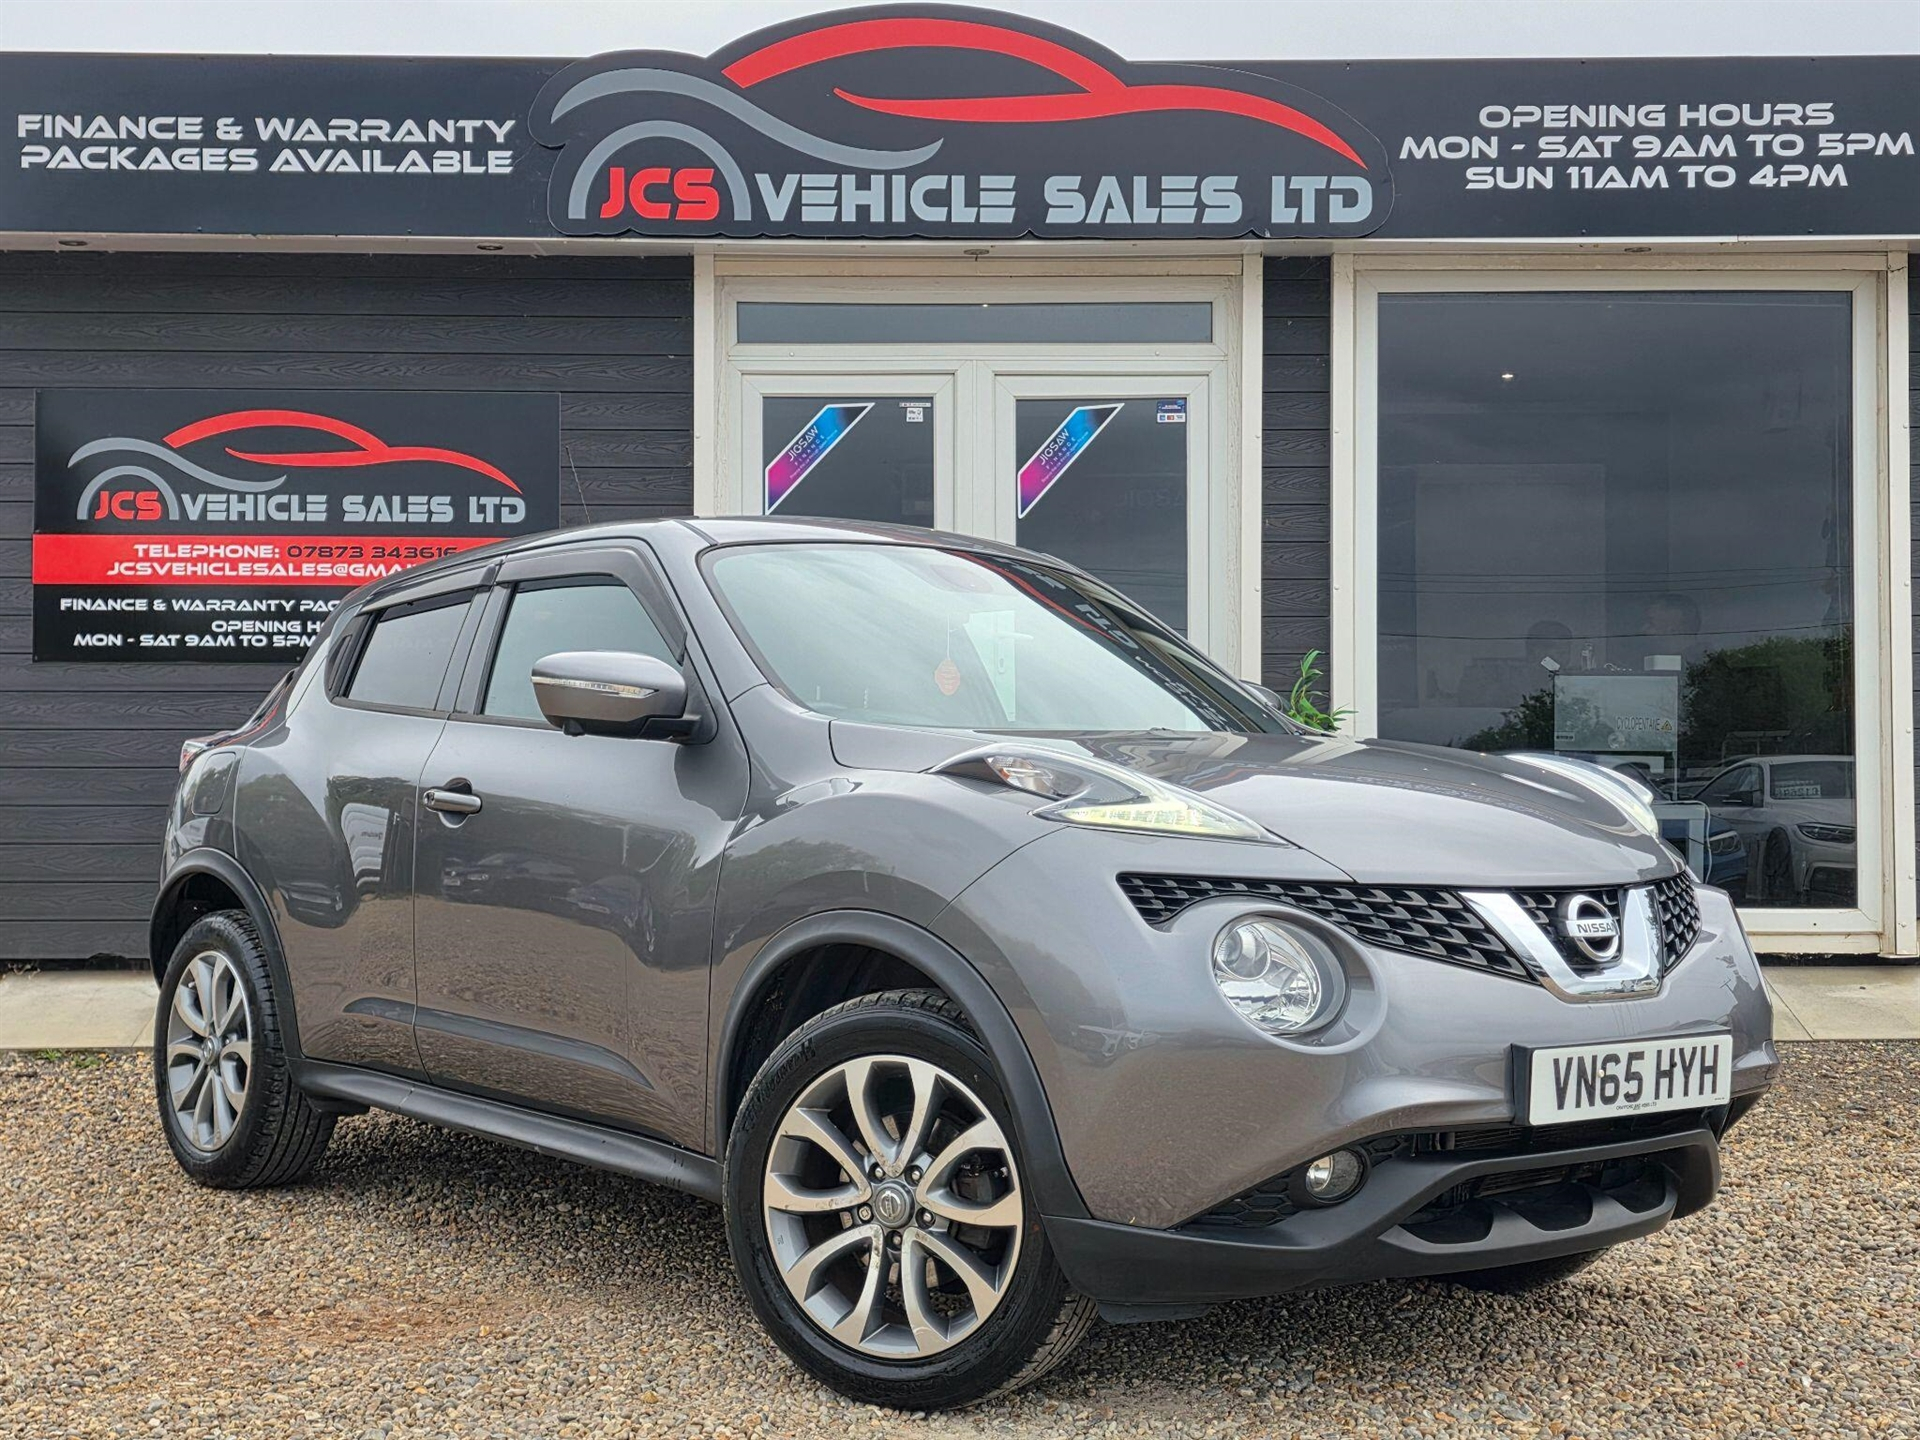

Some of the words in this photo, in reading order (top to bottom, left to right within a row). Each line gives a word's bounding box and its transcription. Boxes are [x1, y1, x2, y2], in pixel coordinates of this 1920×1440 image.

[17, 114, 204, 140] FINANCE
[216, 117, 243, 141] &
[254, 117, 516, 143] WARRANTY
[1478, 104, 1666, 128] OPENING
[1679, 102, 1835, 127] HOURS
[20, 145, 259, 172] PACKAGES
[268, 148, 514, 174] AVAILABLE
[1399, 135, 1498, 160] MON
[1537, 135, 1623, 159] SAT
[1632, 134, 1738, 158] 9AM
[1745, 133, 1805, 157] TO
[1817, 132, 1915, 157] 5PM
[1465, 166, 1554, 190] SUN
[1566, 165, 1670, 189] 11AM
[1677, 164, 1737, 189] TO
[1748, 163, 1849, 188] 4PM
[600, 167, 720, 221] JCS
[754, 173, 1017, 224] VEHICLE
[1043, 175, 1243, 224] SALES
[1270, 175, 1374, 224] LTD
[788, 425, 819, 461] JIGSAW
[1039, 428, 1069, 465] JIGSAW
[94, 490, 160, 520] JCS
[184, 494, 328, 522] VEHICLE
[342, 495, 454, 523] SALES
[468, 496, 526, 523] LTD
[133, 544, 280, 559] TELEPHONE:
[286, 545, 364, 559] 07873
[60, 598, 149, 611] FINANCE
[152, 598, 167, 611] &
[171, 598, 296, 612] WARRANTY
[73, 633, 123, 647] MON
[139, 634, 181, 647] SAT
[184, 634, 236, 647] 9AM
[238, 634, 268, 647] TO
[211, 620, 302, 633] OPENING
[1552, 1050, 1646, 1111] VN65
[1654, 1044, 1720, 1100] HYH
